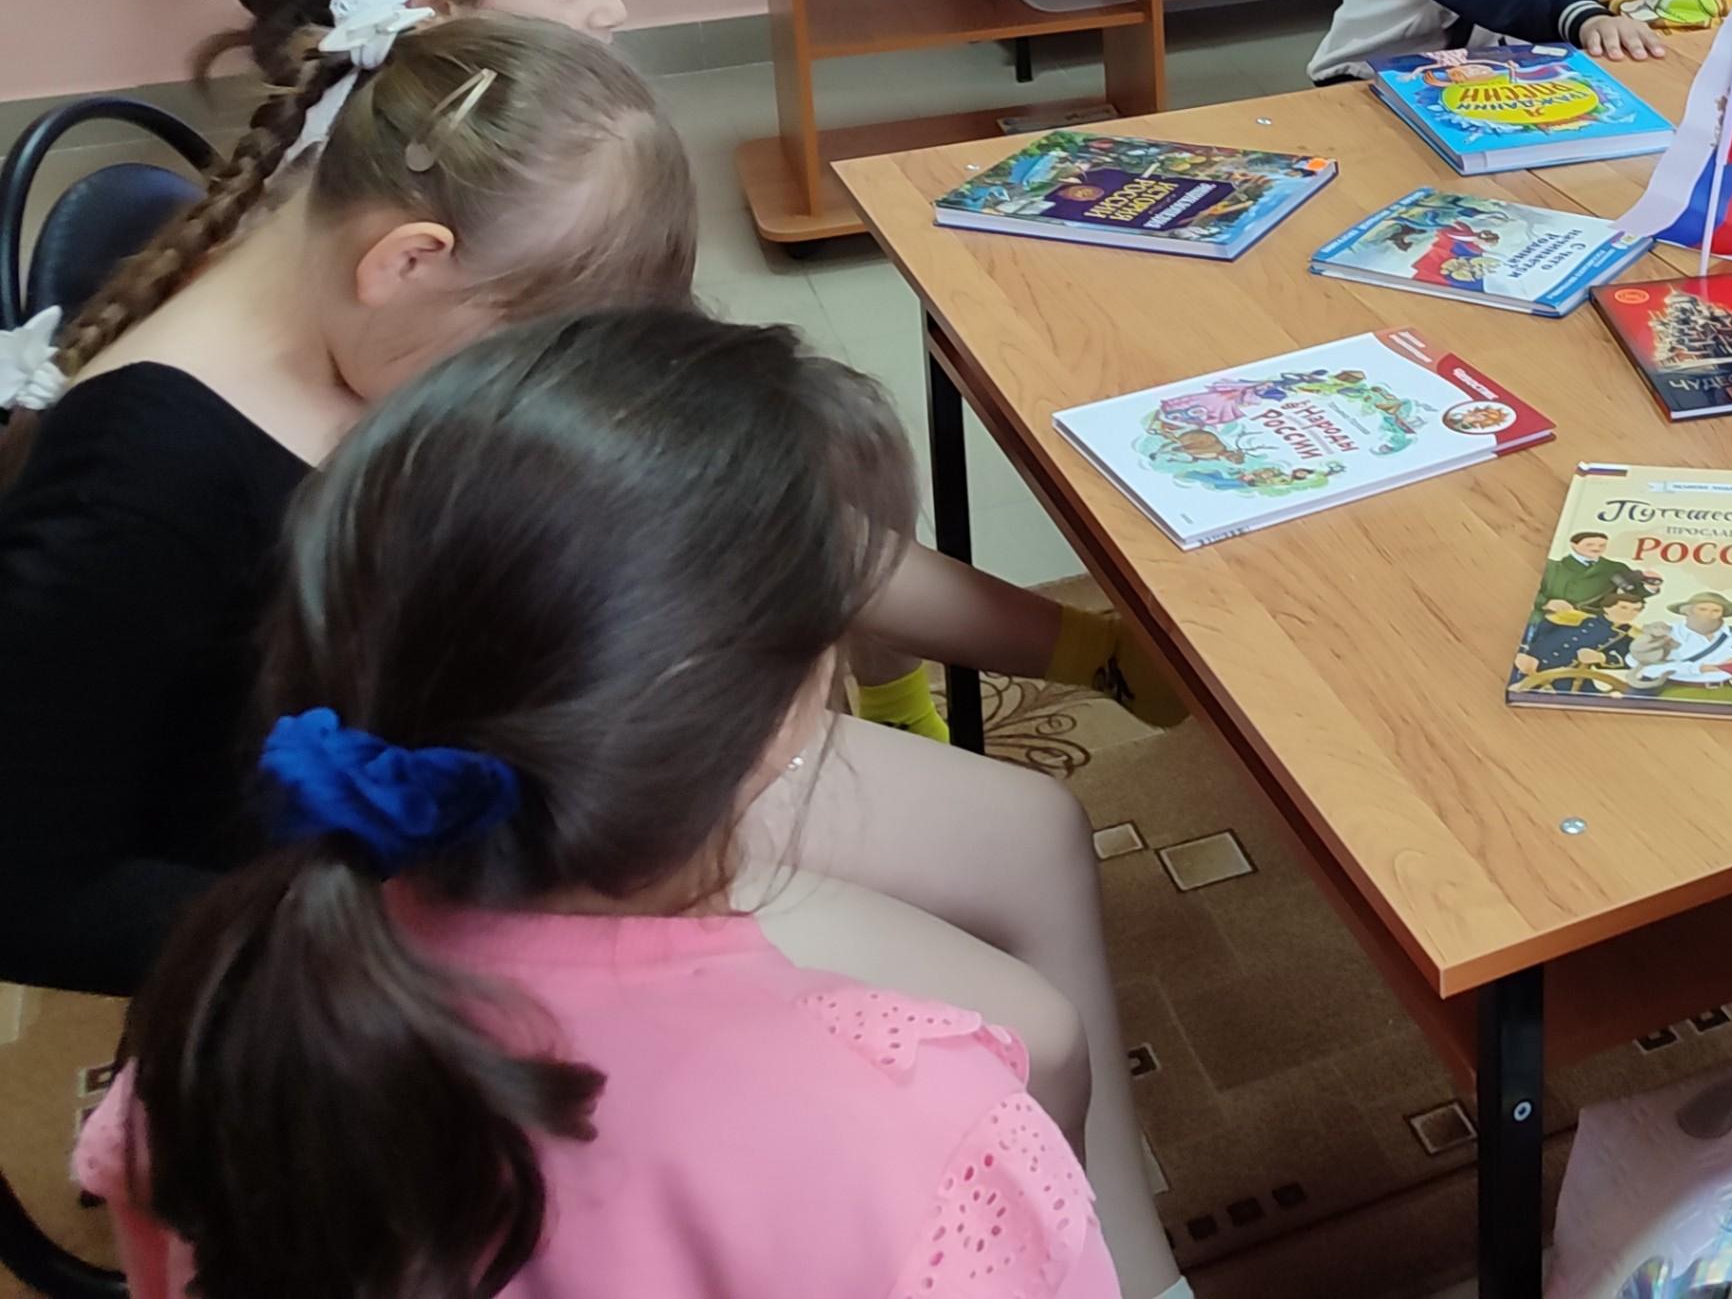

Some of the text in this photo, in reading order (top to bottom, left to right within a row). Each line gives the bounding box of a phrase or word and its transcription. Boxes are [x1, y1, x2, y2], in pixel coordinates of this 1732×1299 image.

[1457, 91, 1589, 111] ГРАЖДАНИН
[1459, 82, 1570, 102] РОССИИ
[1084, 178, 1156, 219] РОССИИ
[1108, 181, 1179, 221] ИСТОРИЯ
[1508, 229, 1583, 279] начинается
[1541, 249, 1571, 271] чего
[1293, 404, 1360, 452] Народы
